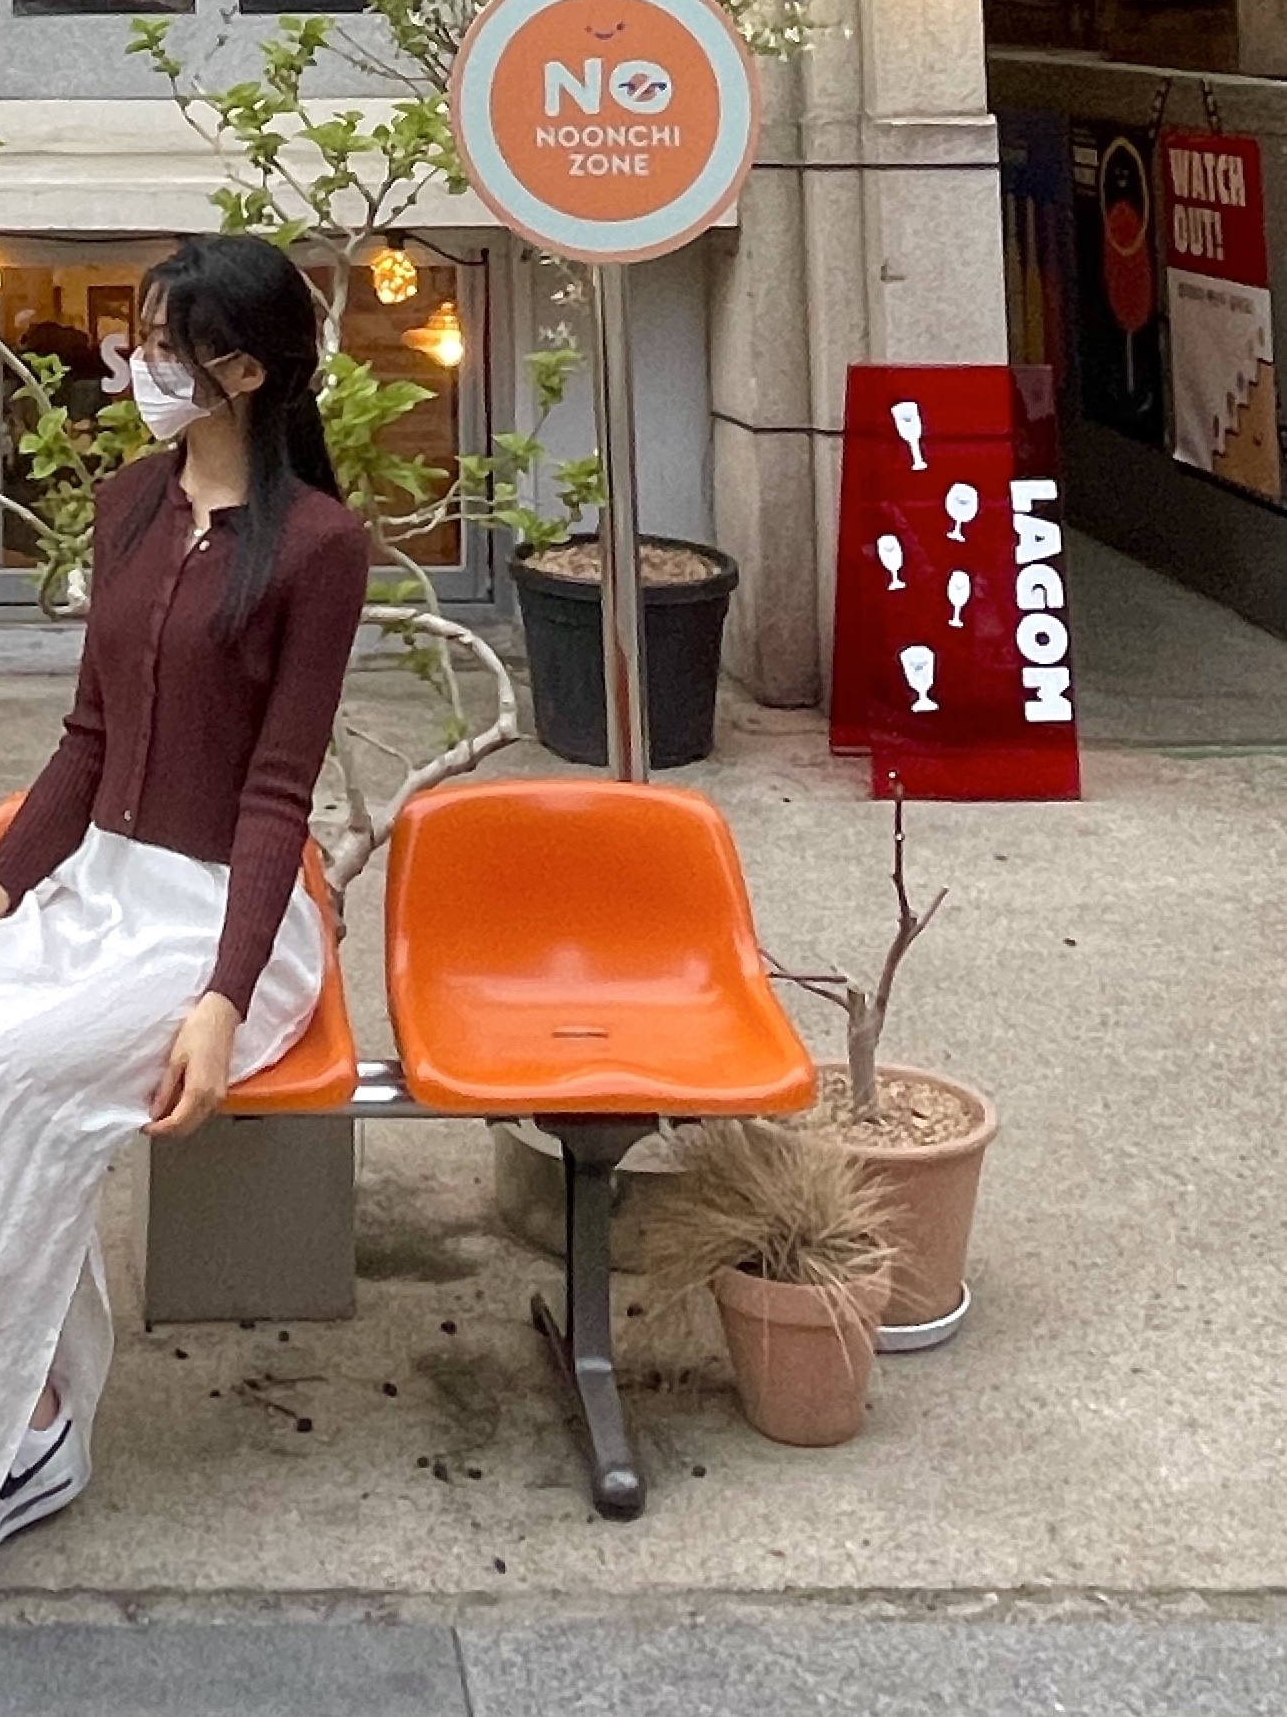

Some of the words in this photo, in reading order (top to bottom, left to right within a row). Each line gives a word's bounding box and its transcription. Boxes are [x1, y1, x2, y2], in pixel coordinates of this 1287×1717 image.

[542, 56, 675, 117] NO
[535, 125, 681, 148] NOONCHI
[568, 154, 651, 177] ZONE
[1168, 147, 1246, 208] WATCH
[1173, 203, 1225, 261] OUT!
[1009, 478, 1073, 723] LAGOM
